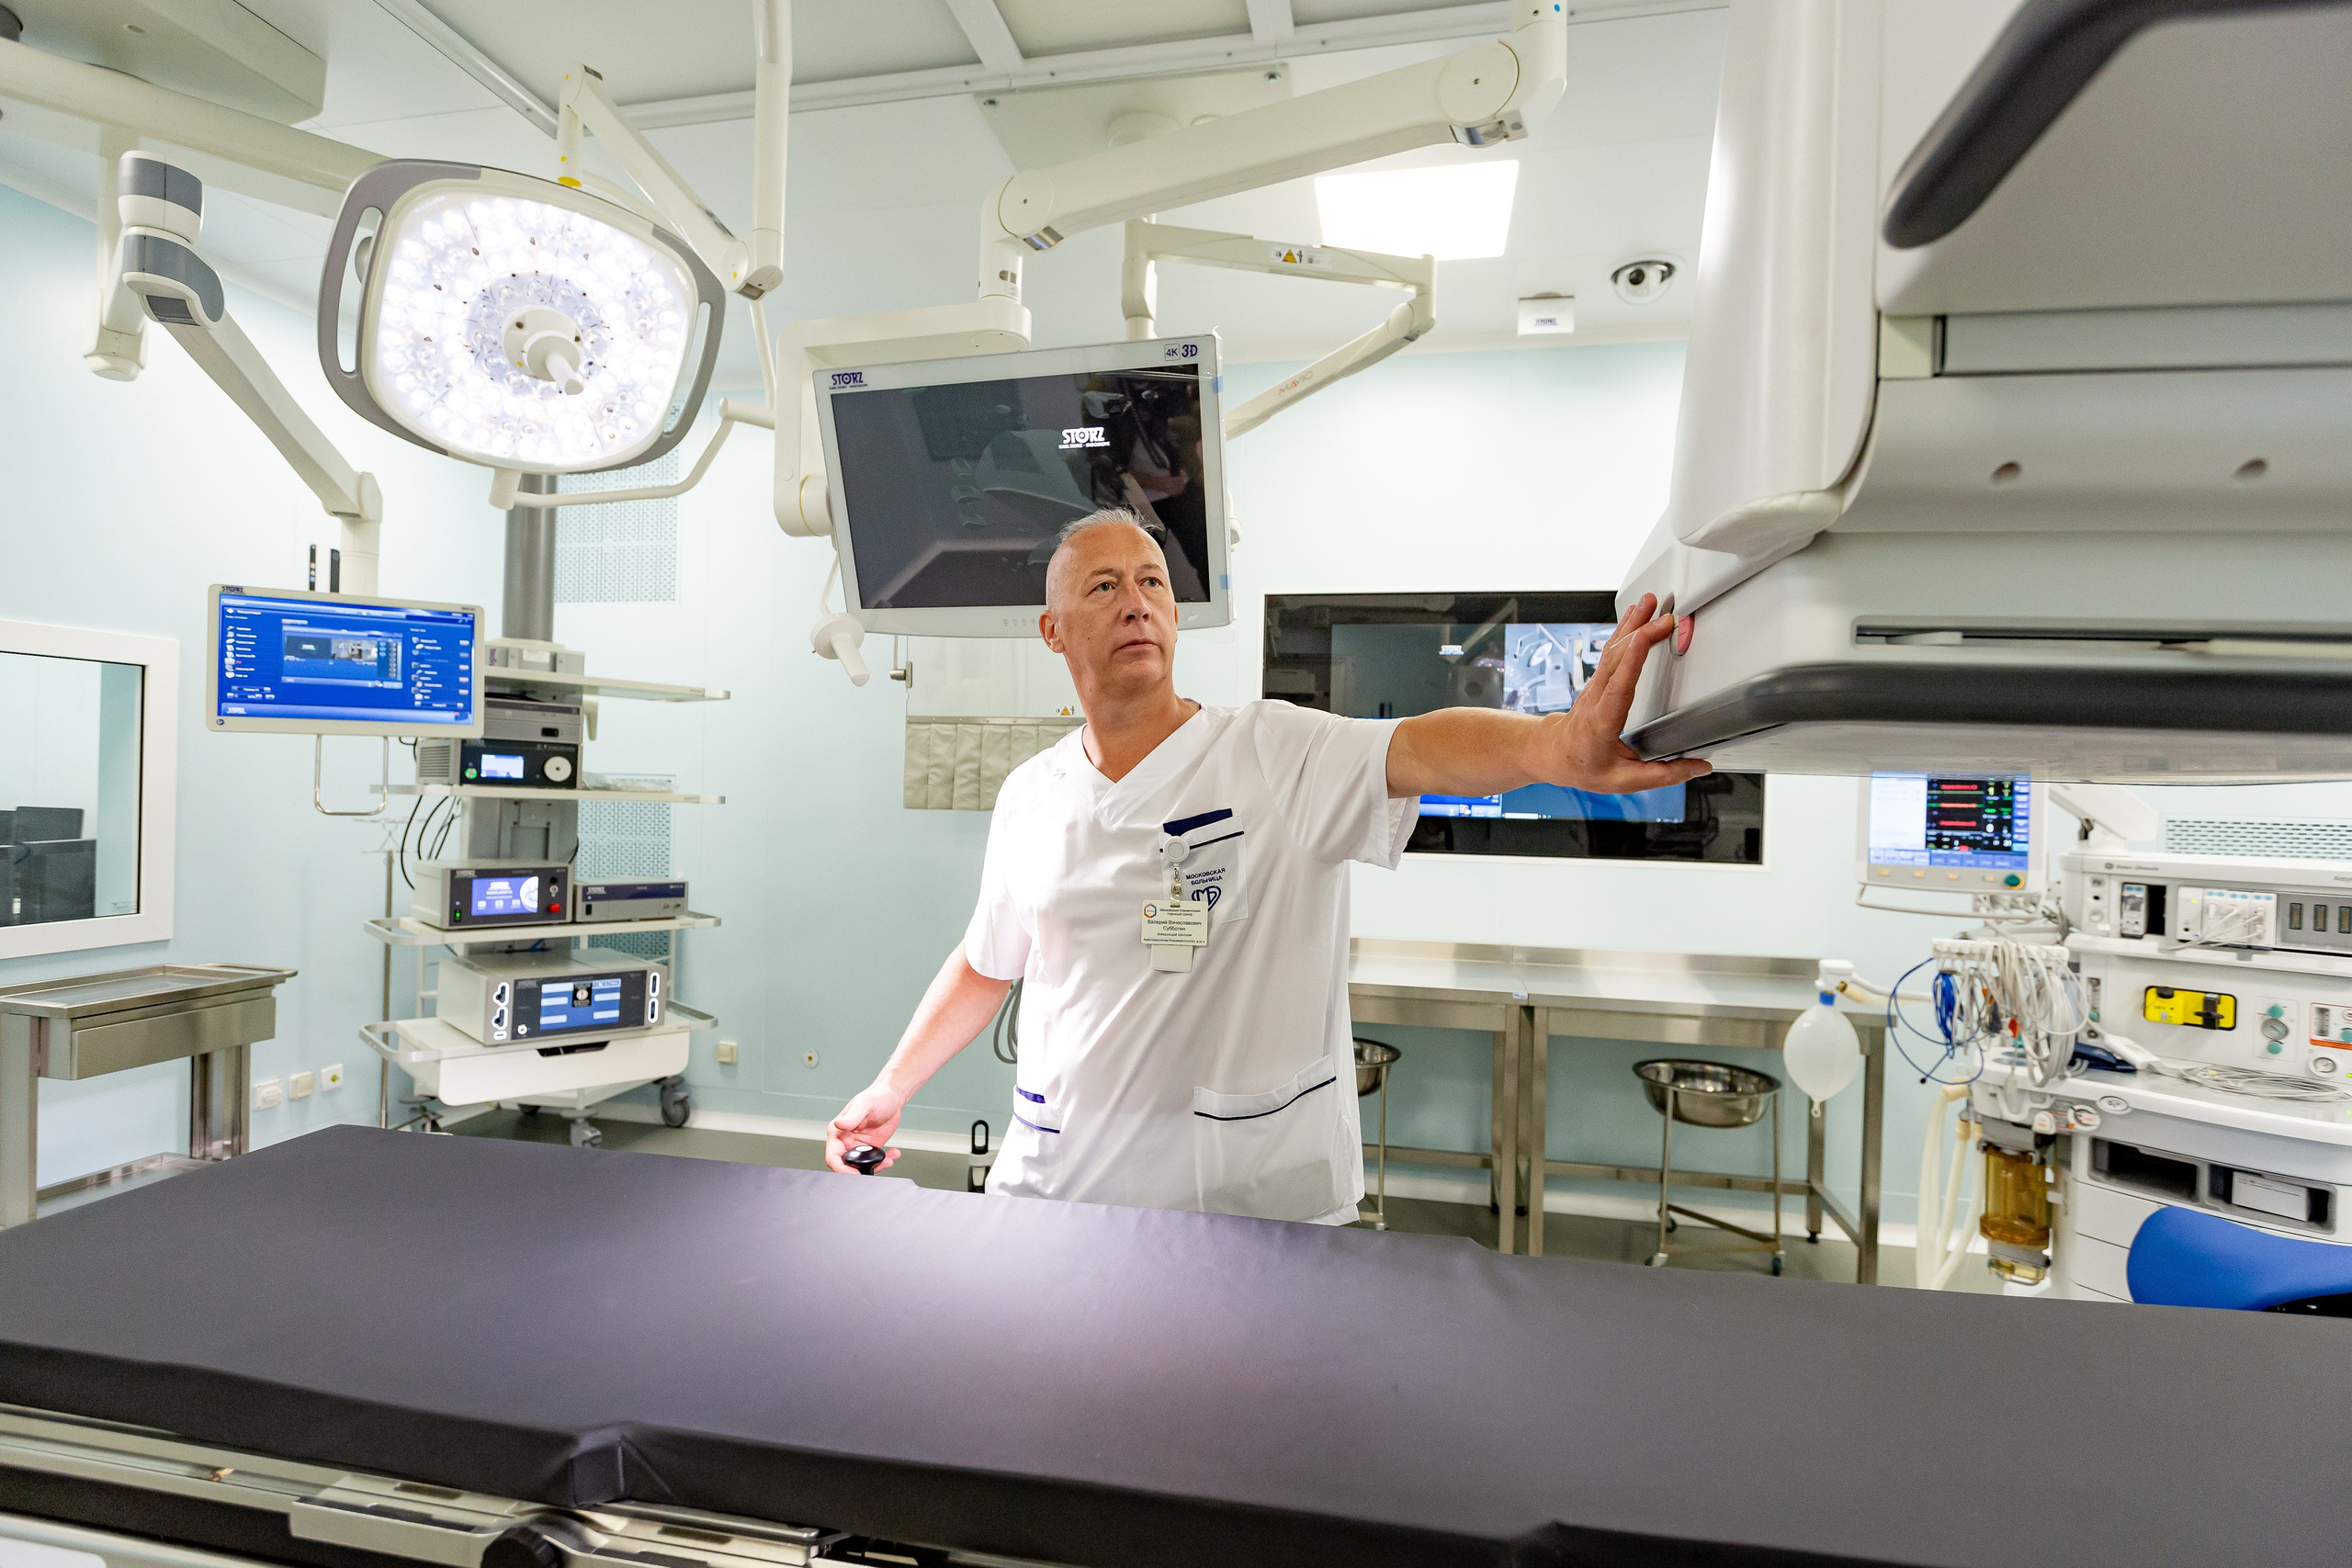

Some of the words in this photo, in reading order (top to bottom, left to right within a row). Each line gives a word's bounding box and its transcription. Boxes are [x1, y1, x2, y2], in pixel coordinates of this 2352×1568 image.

[1166, 348, 1179, 356] 4K
[1182, 344, 1198, 358] 3D
[831, 371, 864, 386] STORZ
[1278, 370, 1313, 395] MAVIG
[1061, 426, 1105, 445] STORZ
[1186, 868, 1226, 879] МОСКОВСКАЯ
[1191, 875, 1223, 886] БОЛЬНИЦА
